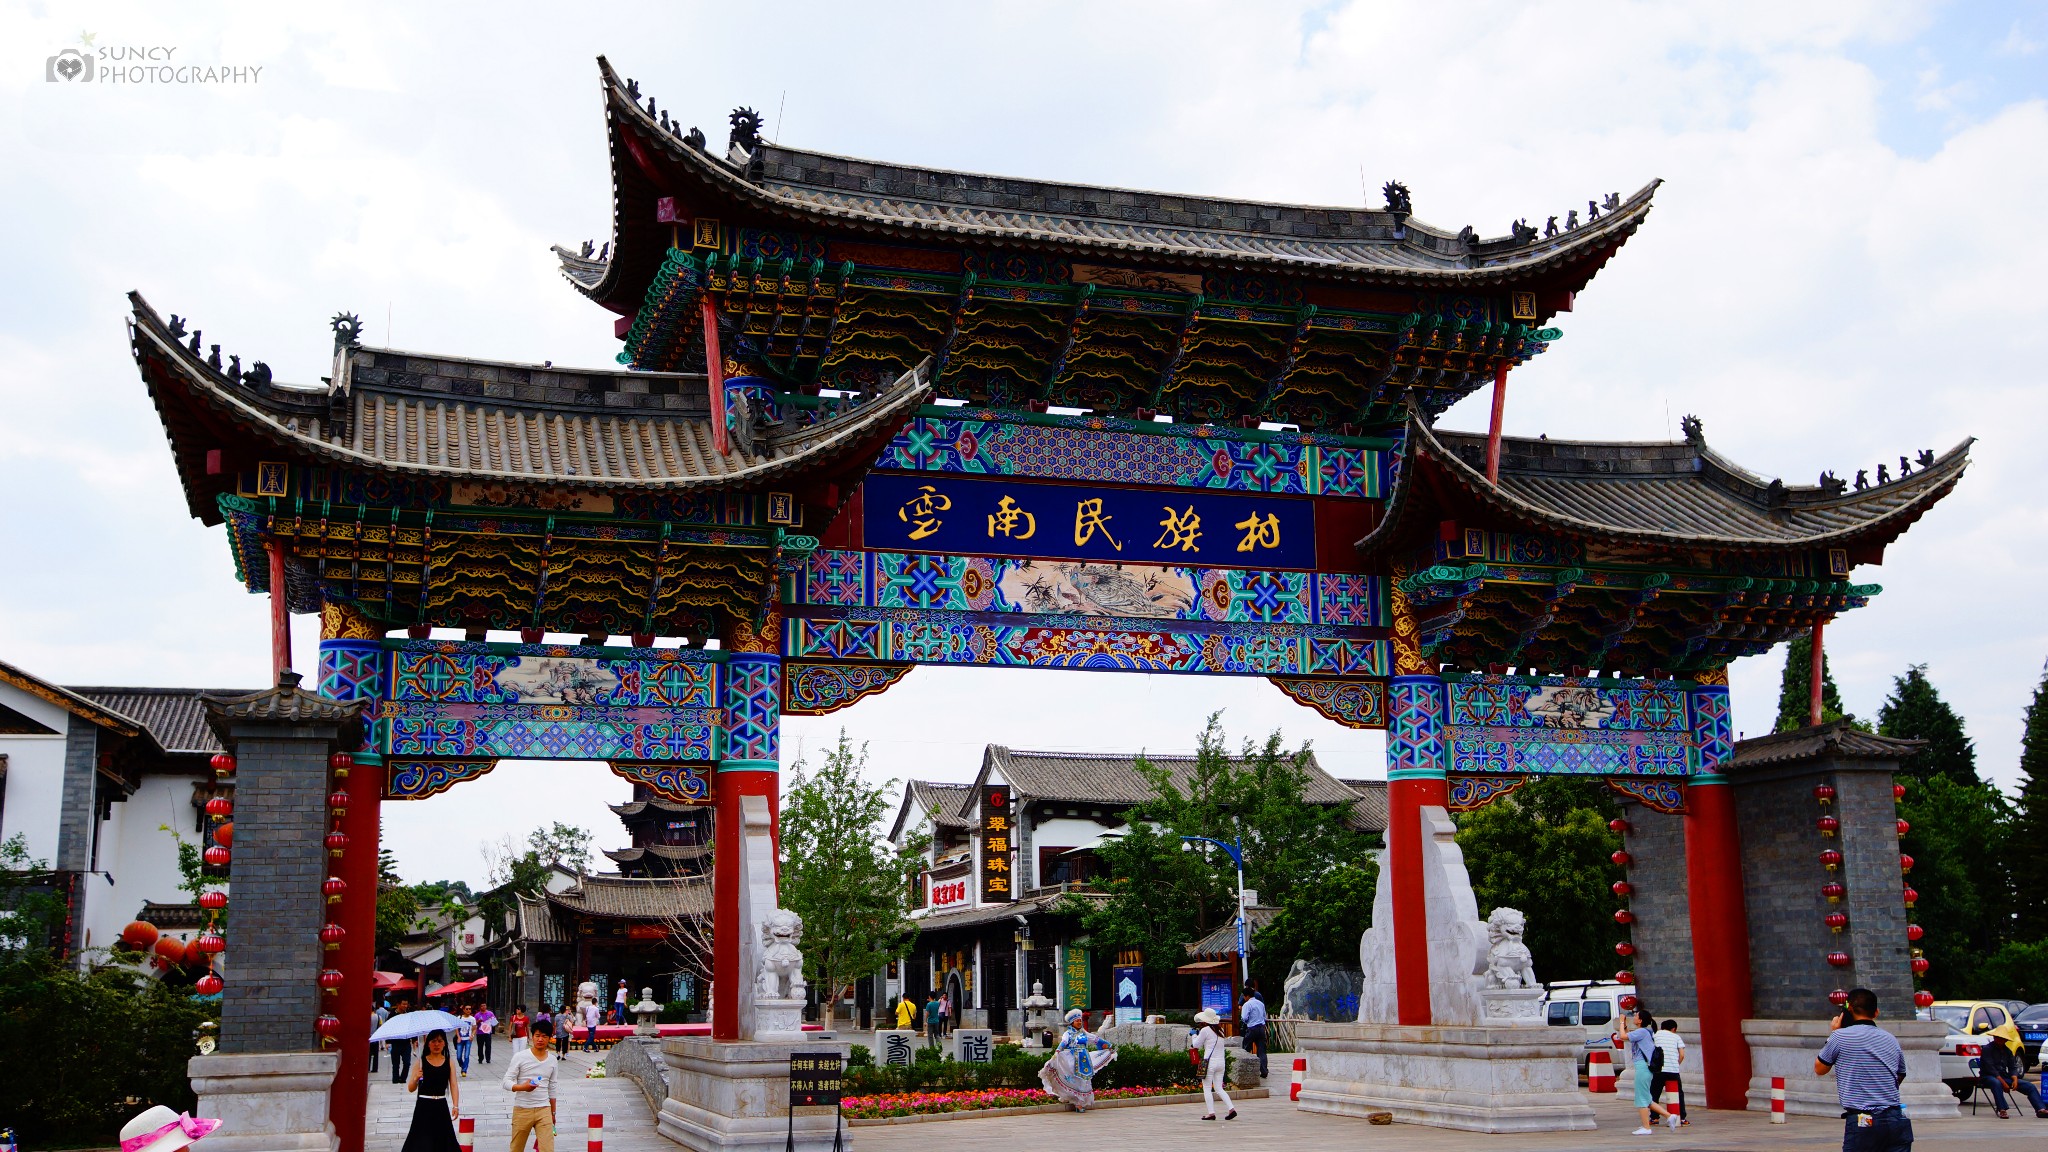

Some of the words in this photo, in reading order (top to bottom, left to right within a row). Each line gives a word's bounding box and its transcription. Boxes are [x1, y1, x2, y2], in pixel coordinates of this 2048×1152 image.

[986, 816, 1009, 893] 翠福珠宝
[1067, 949, 1087, 1008] 翠福珠宝
[790, 1079, 814, 1091] 不得入内
